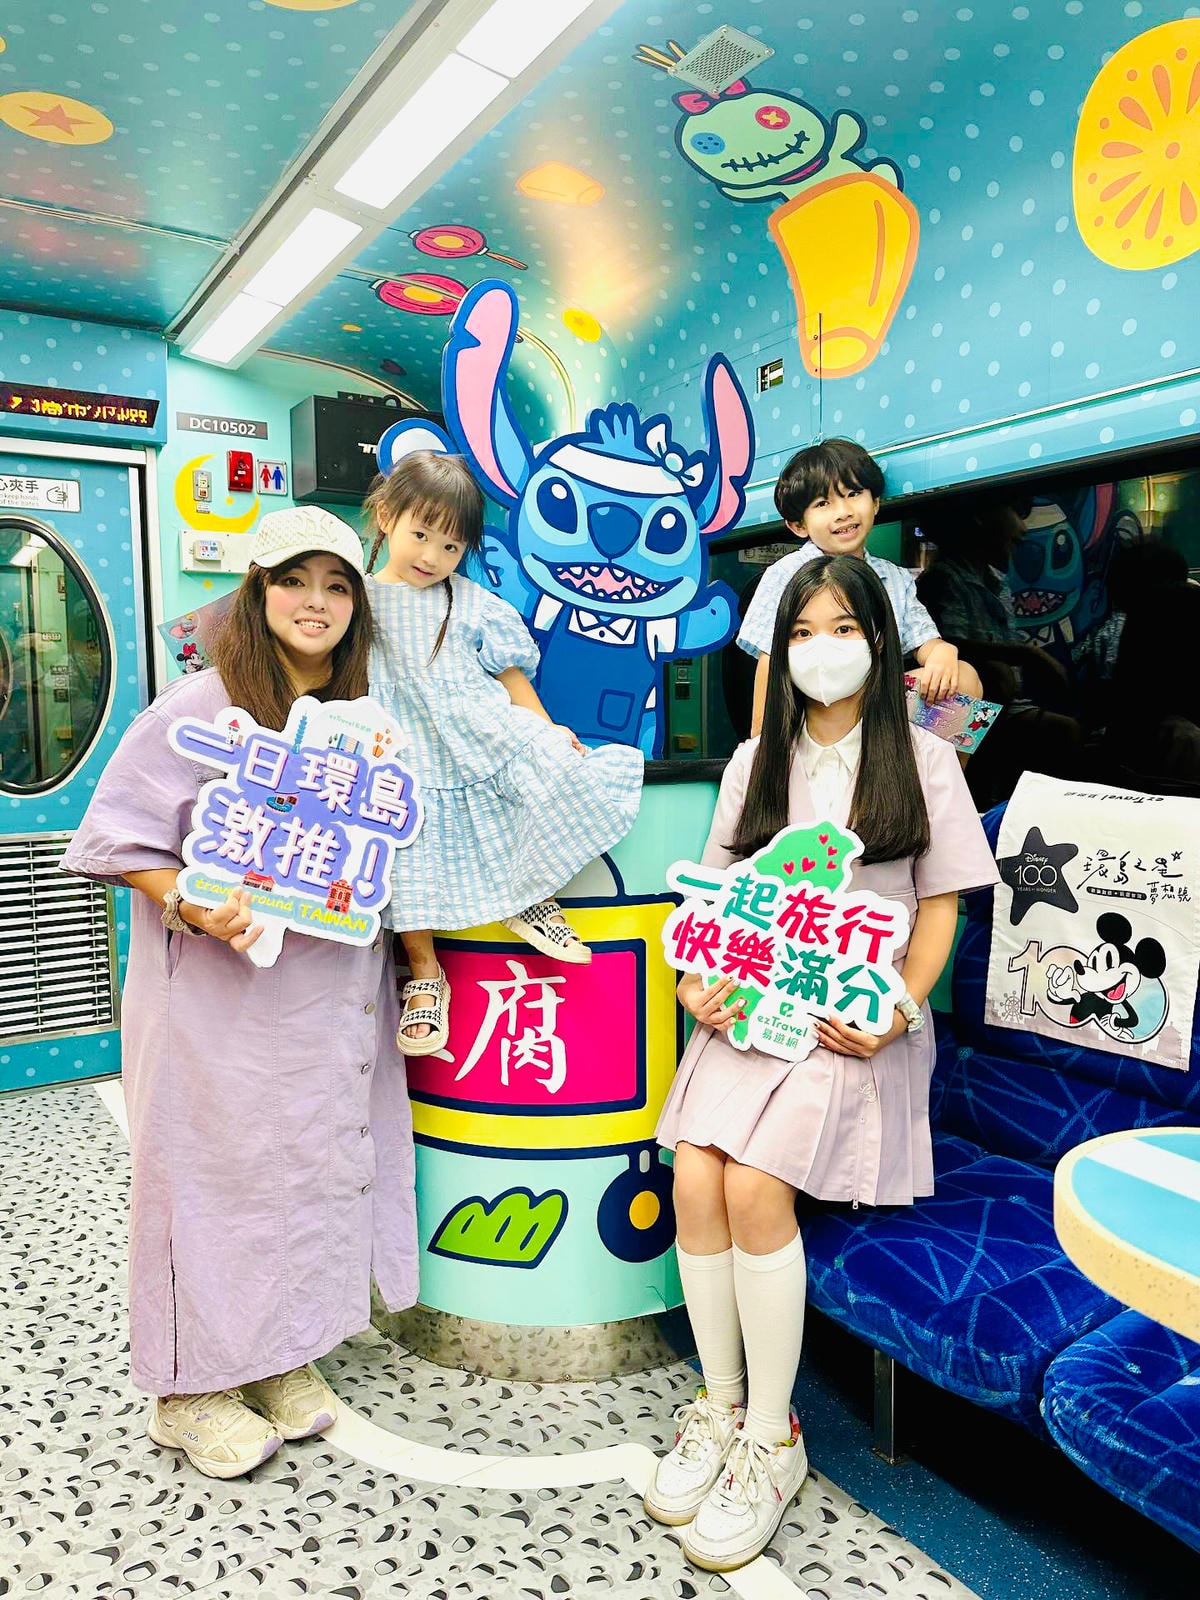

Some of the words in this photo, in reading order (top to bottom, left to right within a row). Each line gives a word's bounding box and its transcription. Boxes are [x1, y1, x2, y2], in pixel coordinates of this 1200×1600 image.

[189, 415, 256, 436] DC10502
[183, 729, 410, 831] 一日環島
[1023, 852, 1049, 865] Disney
[1014, 864, 1058, 886] 100
[251, 893, 294, 911] round
[300, 903, 368, 932] TAIWAN
[676, 872, 895, 964] 一起旅行
[672, 911, 891, 1024] 快樂滿分
[757, 1015, 809, 1037] ezTravel
